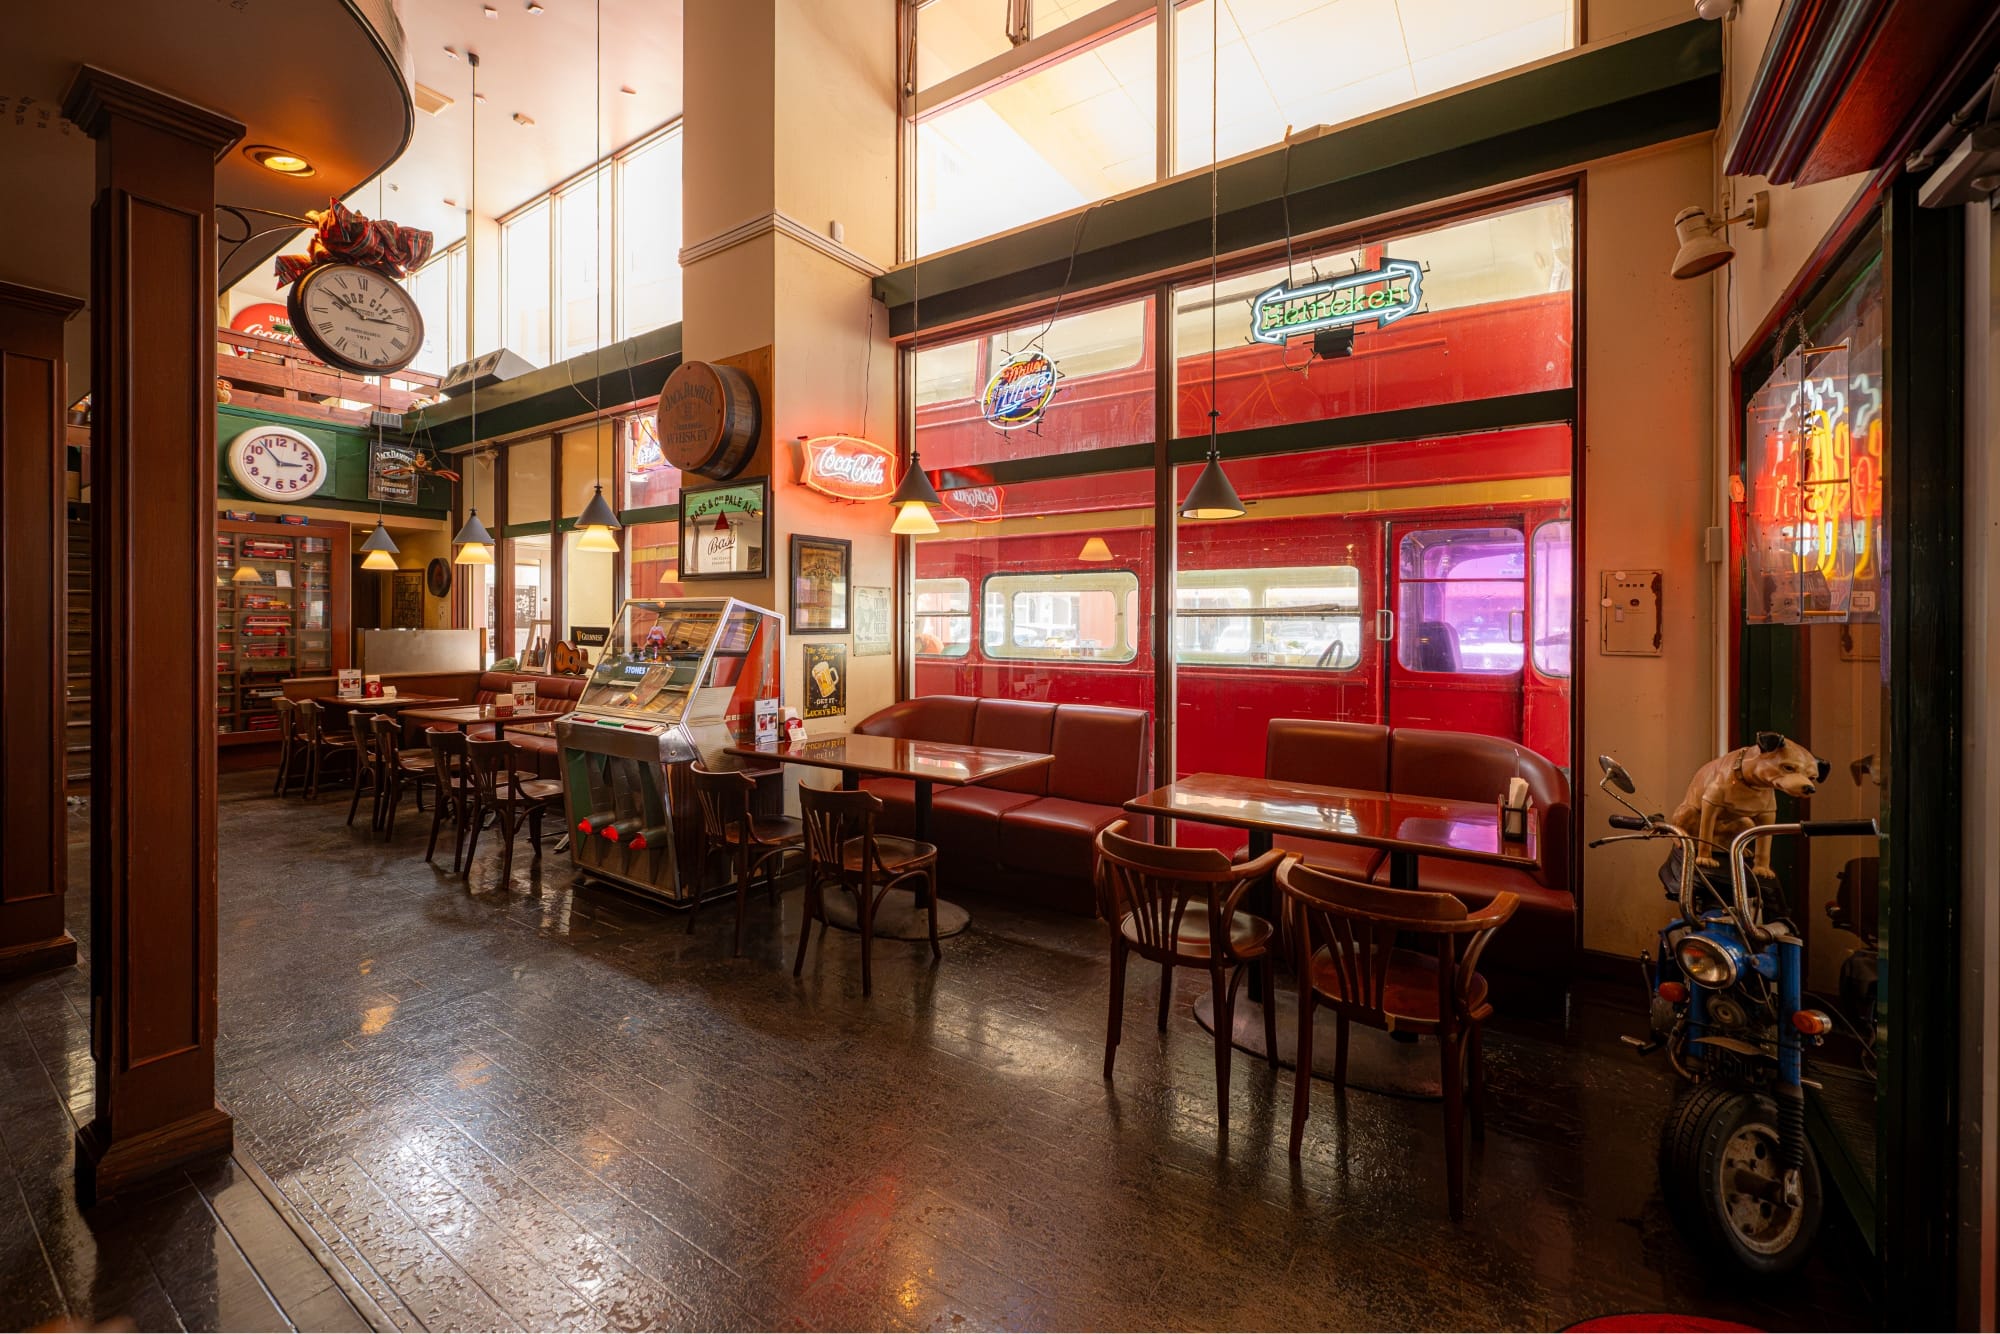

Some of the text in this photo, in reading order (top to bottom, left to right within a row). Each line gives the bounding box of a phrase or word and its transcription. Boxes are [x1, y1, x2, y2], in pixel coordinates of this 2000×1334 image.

[331, 292, 364, 311] DDGE
[369, 298, 393, 321] CITY
[1262, 286, 1406, 330] Heineken
[269, 314, 290, 325] DRIN
[1002, 358, 1049, 384] Miller
[984, 371, 1052, 419] Lite
[666, 430, 708, 444] WHISKEY
[264, 439, 273, 448] 11
[276, 437, 287, 448] 12
[251, 445, 263, 455] 10
[246, 455, 254, 464] 9
[301, 451, 309, 460] 2
[250, 466, 259, 476] 8
[305, 463, 313, 472] 3
[818, 447, 886, 485] Coca-Cola
[262, 475, 271, 485] 7
[300, 473, 308, 482] 4
[275, 480, 283, 489] 6
[289, 479, 297, 489] 5
[377, 486, 409, 495] WHISKEY
[690, 503, 707, 523] BASS
[708, 499, 713, 509] &
[725, 494, 743, 507] PALE
[743, 501, 758, 518] ALE
[708, 535, 736, 556] Bass
[582, 632, 604, 642] GUINNESS
[624, 665, 646, 675] STONES
[831, 705, 845, 714] BAR
